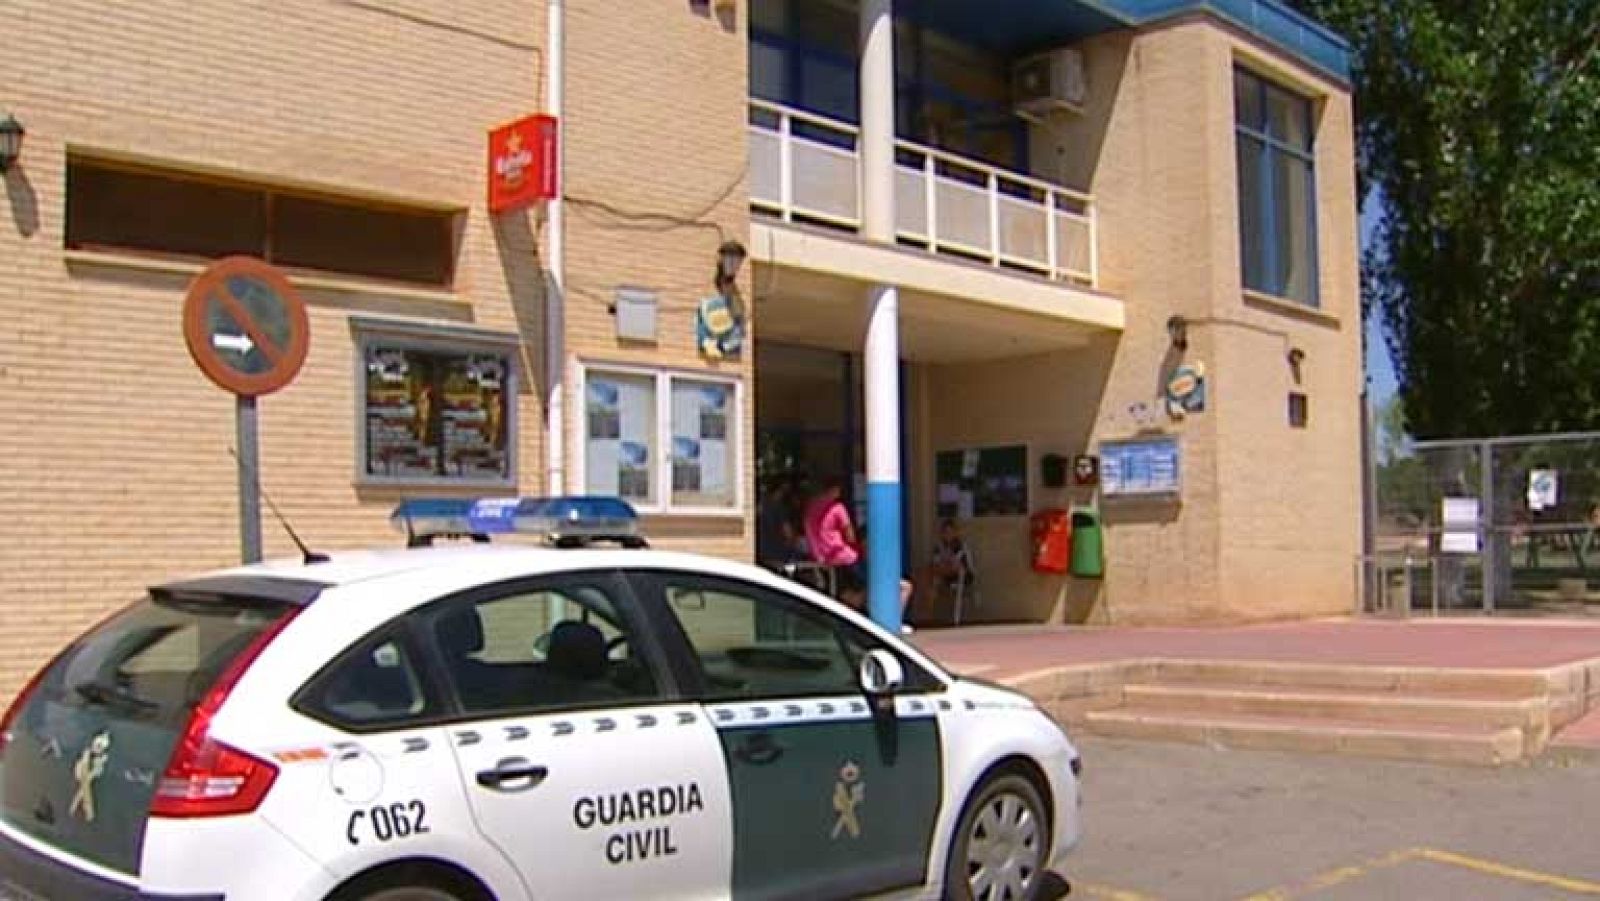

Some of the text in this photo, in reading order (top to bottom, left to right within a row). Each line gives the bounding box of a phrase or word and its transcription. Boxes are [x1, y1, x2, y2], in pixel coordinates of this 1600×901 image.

[371, 800, 430, 841] 062
[574, 783, 704, 829] GUARDIA
[606, 827, 677, 863] CIVIL
